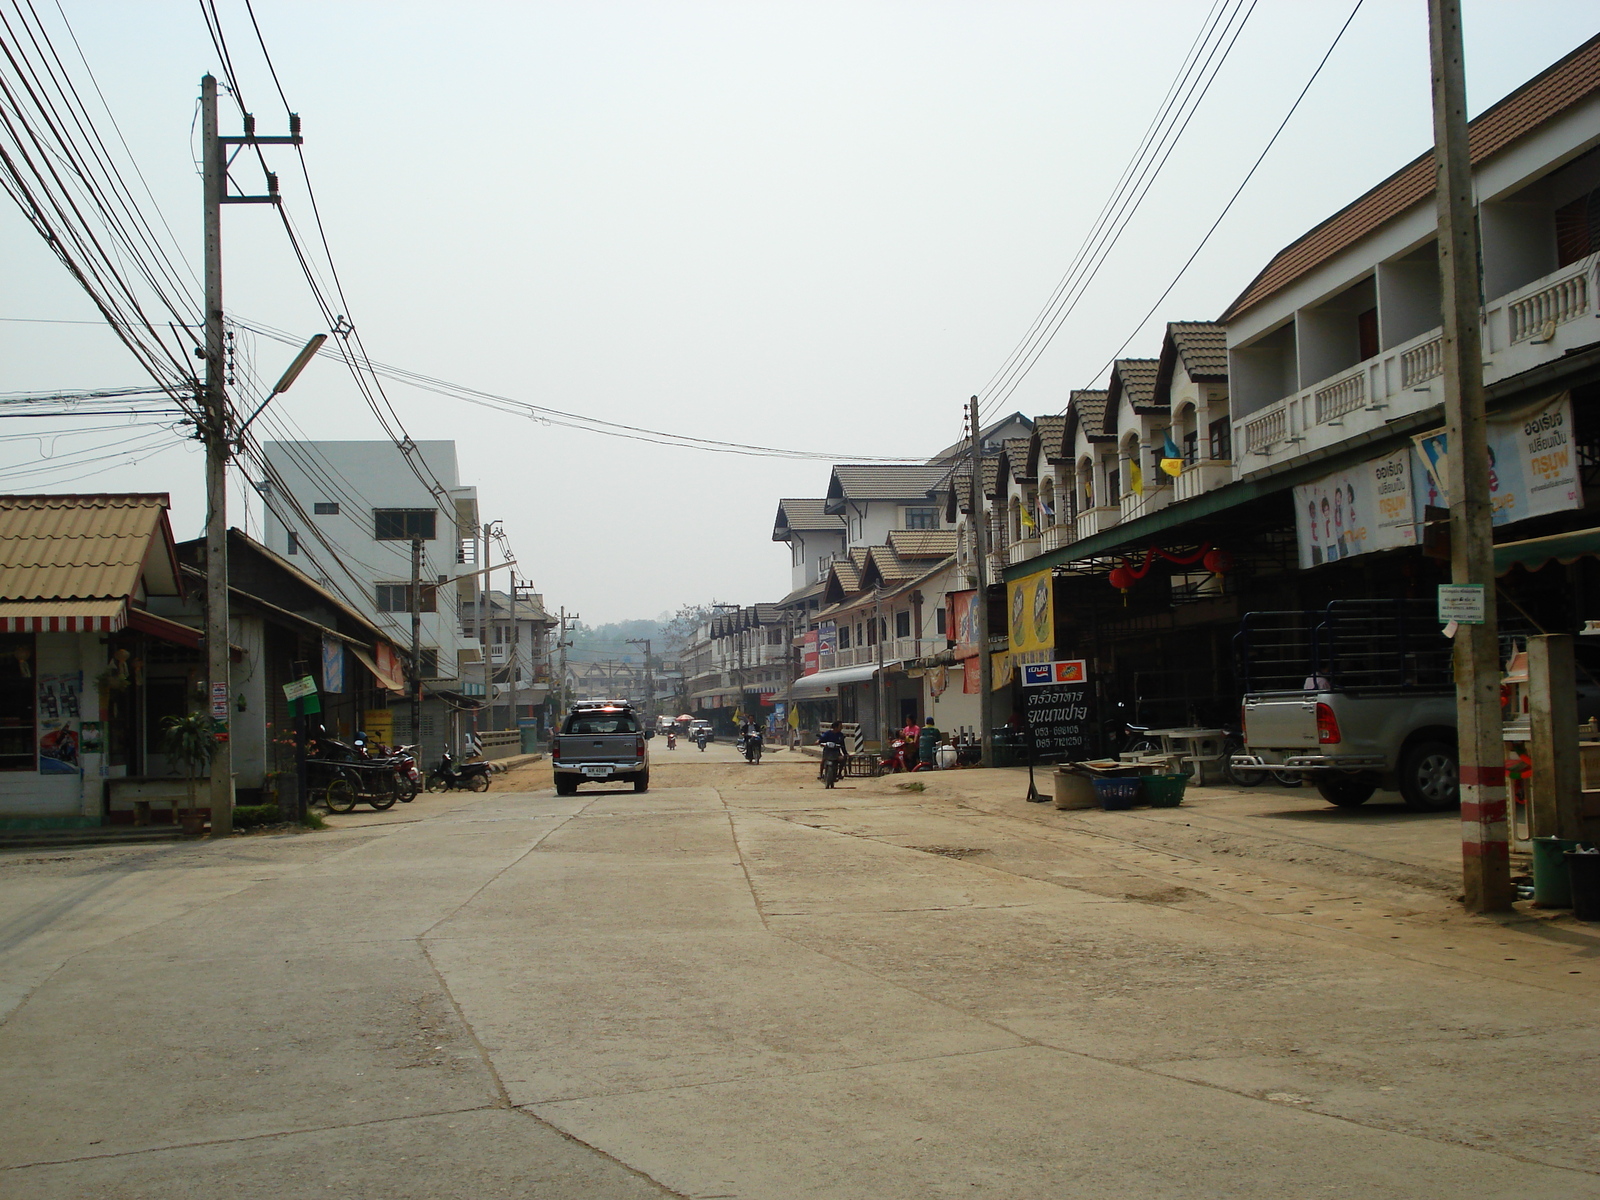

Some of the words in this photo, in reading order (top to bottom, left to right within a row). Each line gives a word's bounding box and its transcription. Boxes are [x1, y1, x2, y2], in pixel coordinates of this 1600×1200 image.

[1531, 445, 1569, 480] ทรูมูฟ
[1027, 689, 1084, 706] ครัวอาหาร
